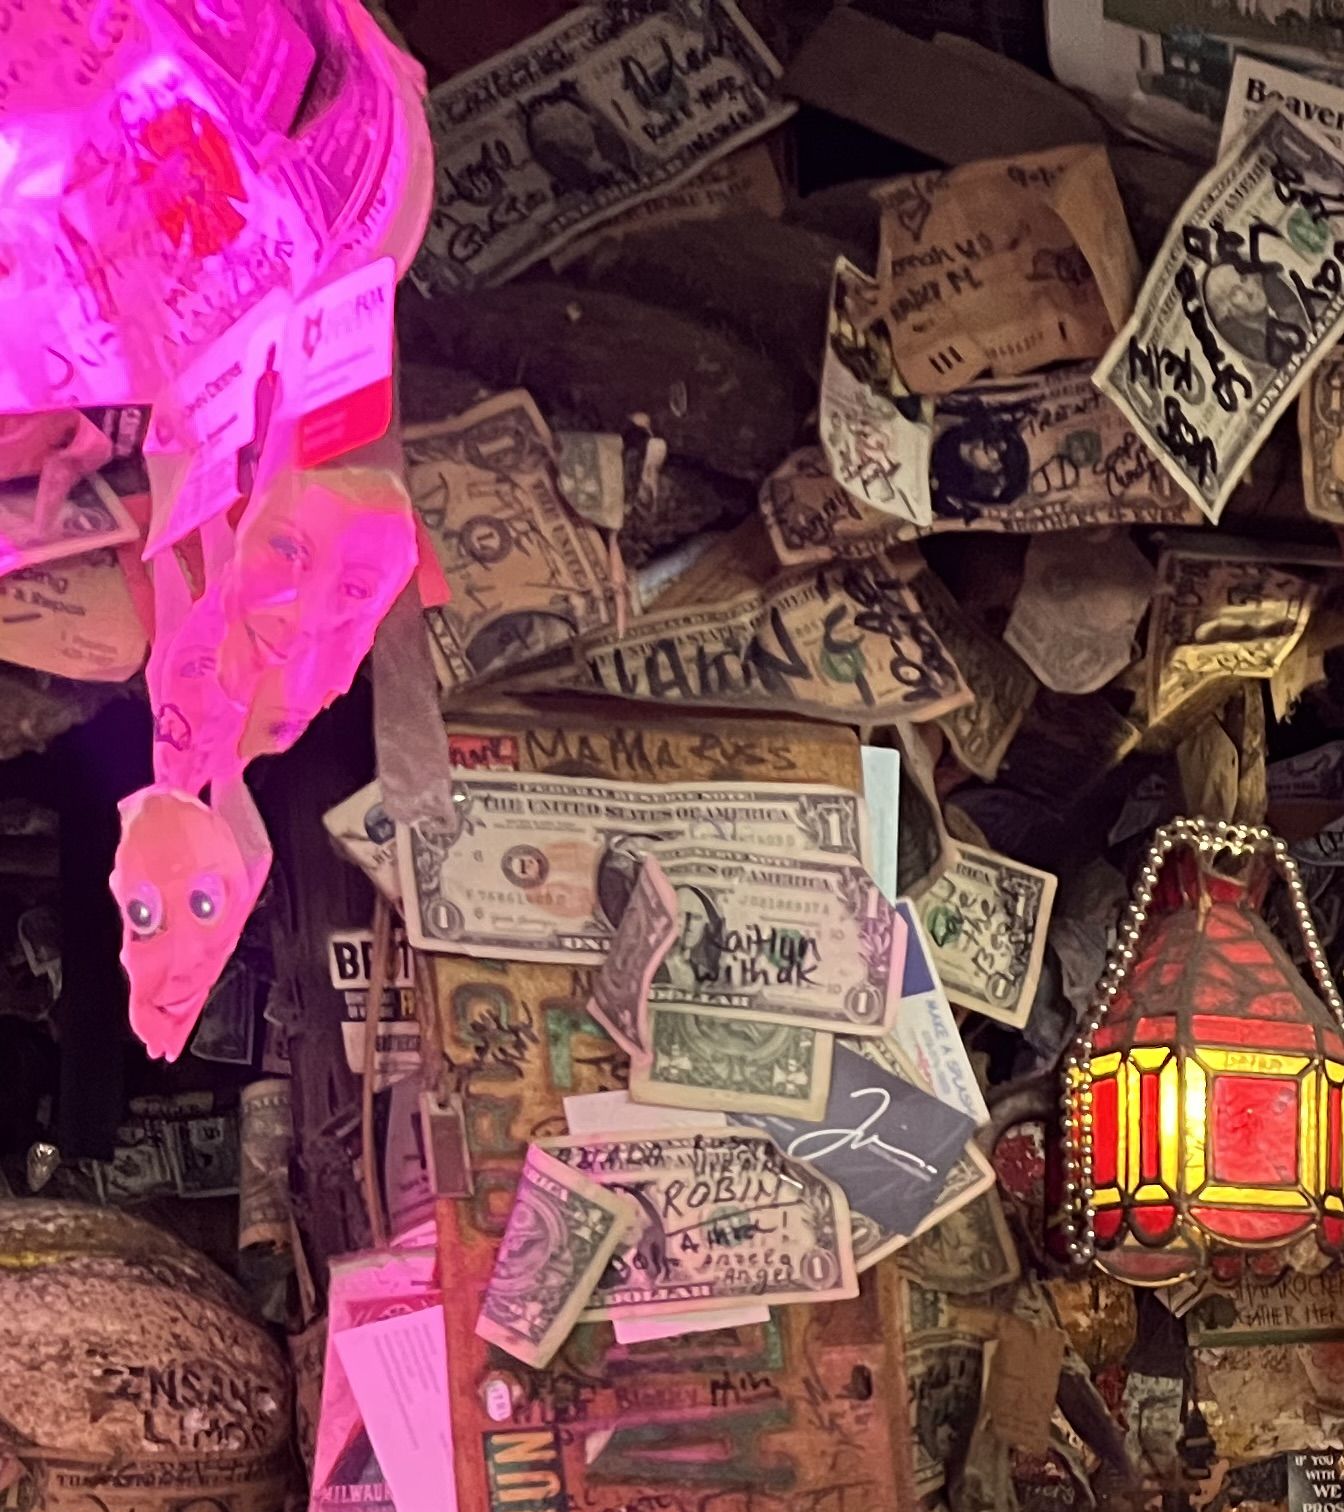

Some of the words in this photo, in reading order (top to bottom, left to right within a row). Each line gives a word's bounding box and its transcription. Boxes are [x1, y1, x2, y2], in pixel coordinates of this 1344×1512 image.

[524, 798, 599, 819] UNITED
[603, 802, 673, 823] STATES
[703, 804, 791, 825] AMERICA
[746, 868, 832, 893] AMERICA
[1310, 1454, 1335, 1468] YOU
[1305, 1468, 1336, 1481] WITH
[1312, 1484, 1344, 1500] WE
